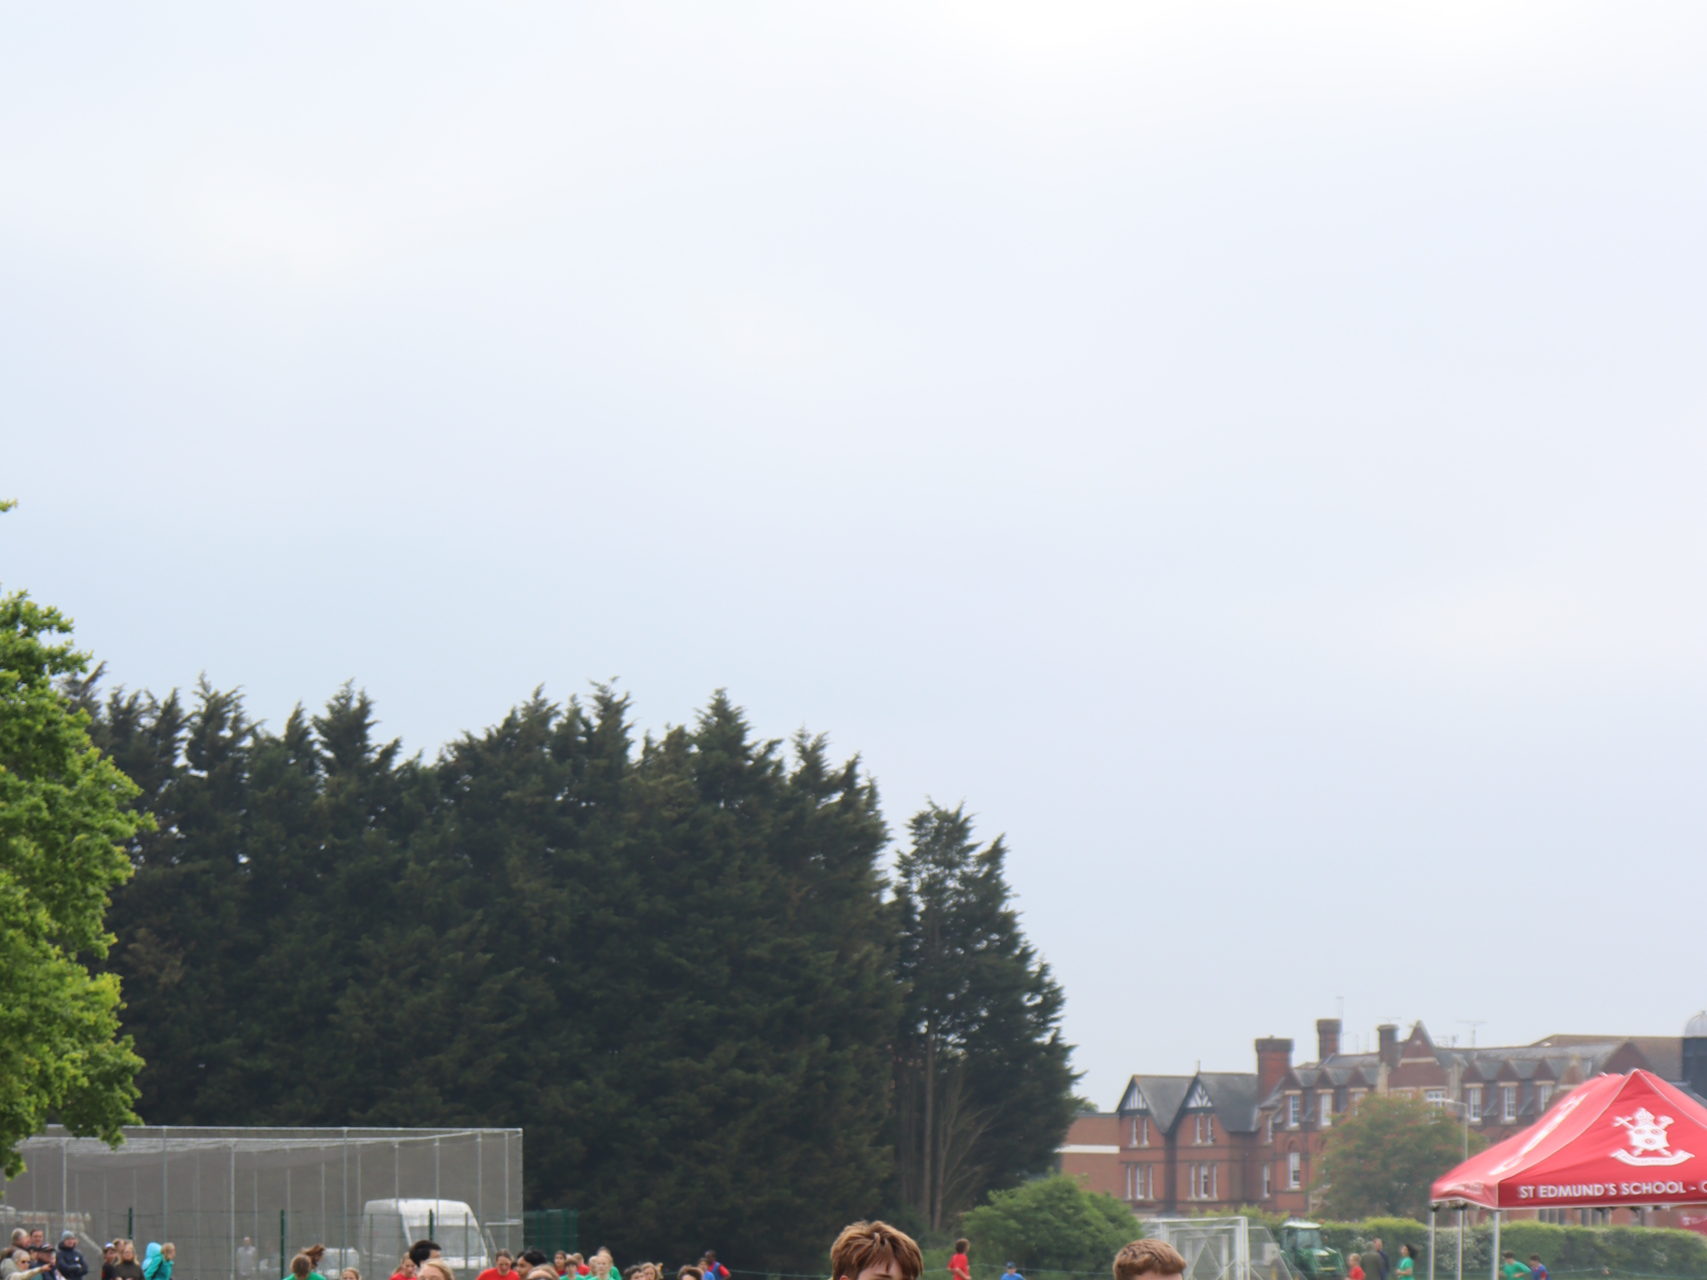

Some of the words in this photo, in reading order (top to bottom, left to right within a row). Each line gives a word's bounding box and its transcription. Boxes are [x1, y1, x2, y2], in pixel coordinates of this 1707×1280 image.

[1519, 1185, 1536, 1199] ST
[1539, 1183, 1618, 1198] EDMUND'S
[1621, 1181, 1687, 1195] SCHOOL
